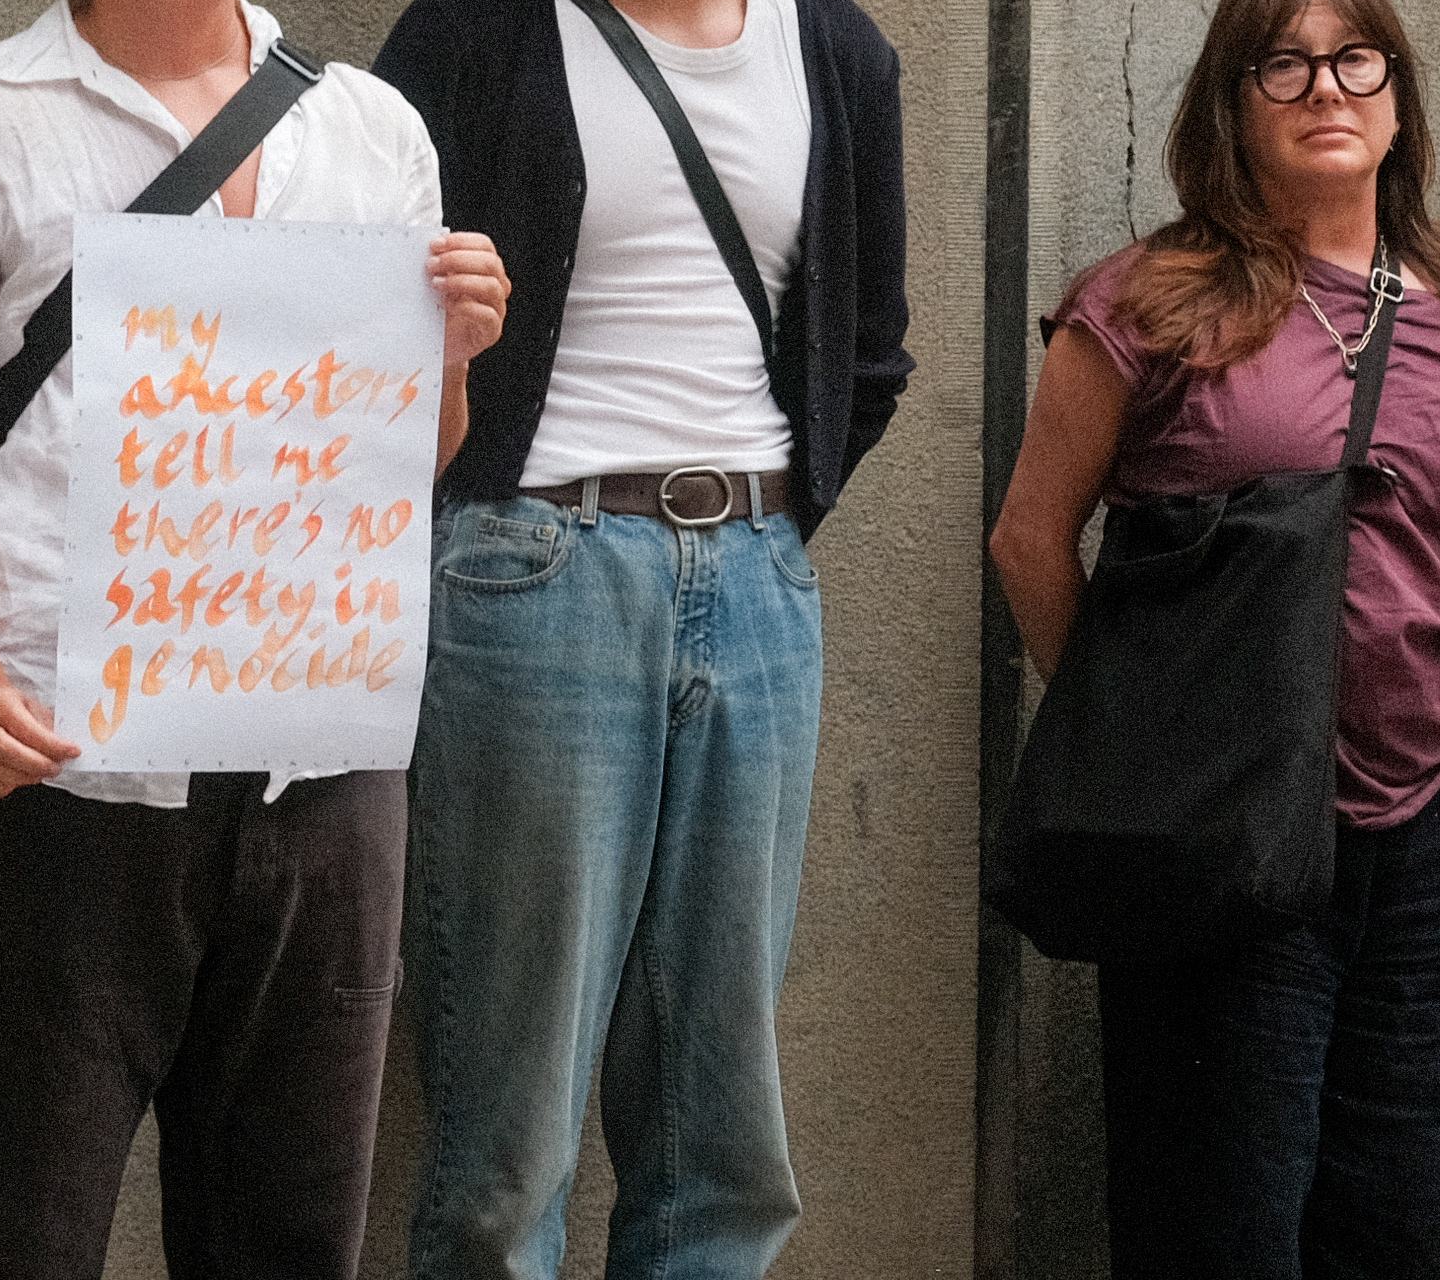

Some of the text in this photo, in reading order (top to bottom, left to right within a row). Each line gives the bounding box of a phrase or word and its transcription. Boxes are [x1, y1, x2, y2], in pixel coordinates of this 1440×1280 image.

[121, 304, 222, 378] my
[120, 350, 424, 427] ancestors
[114, 420, 353, 488] tell me
[109, 491, 413, 562] there's no
[104, 561, 403, 652] safety in
[89, 623, 406, 745] genocide
